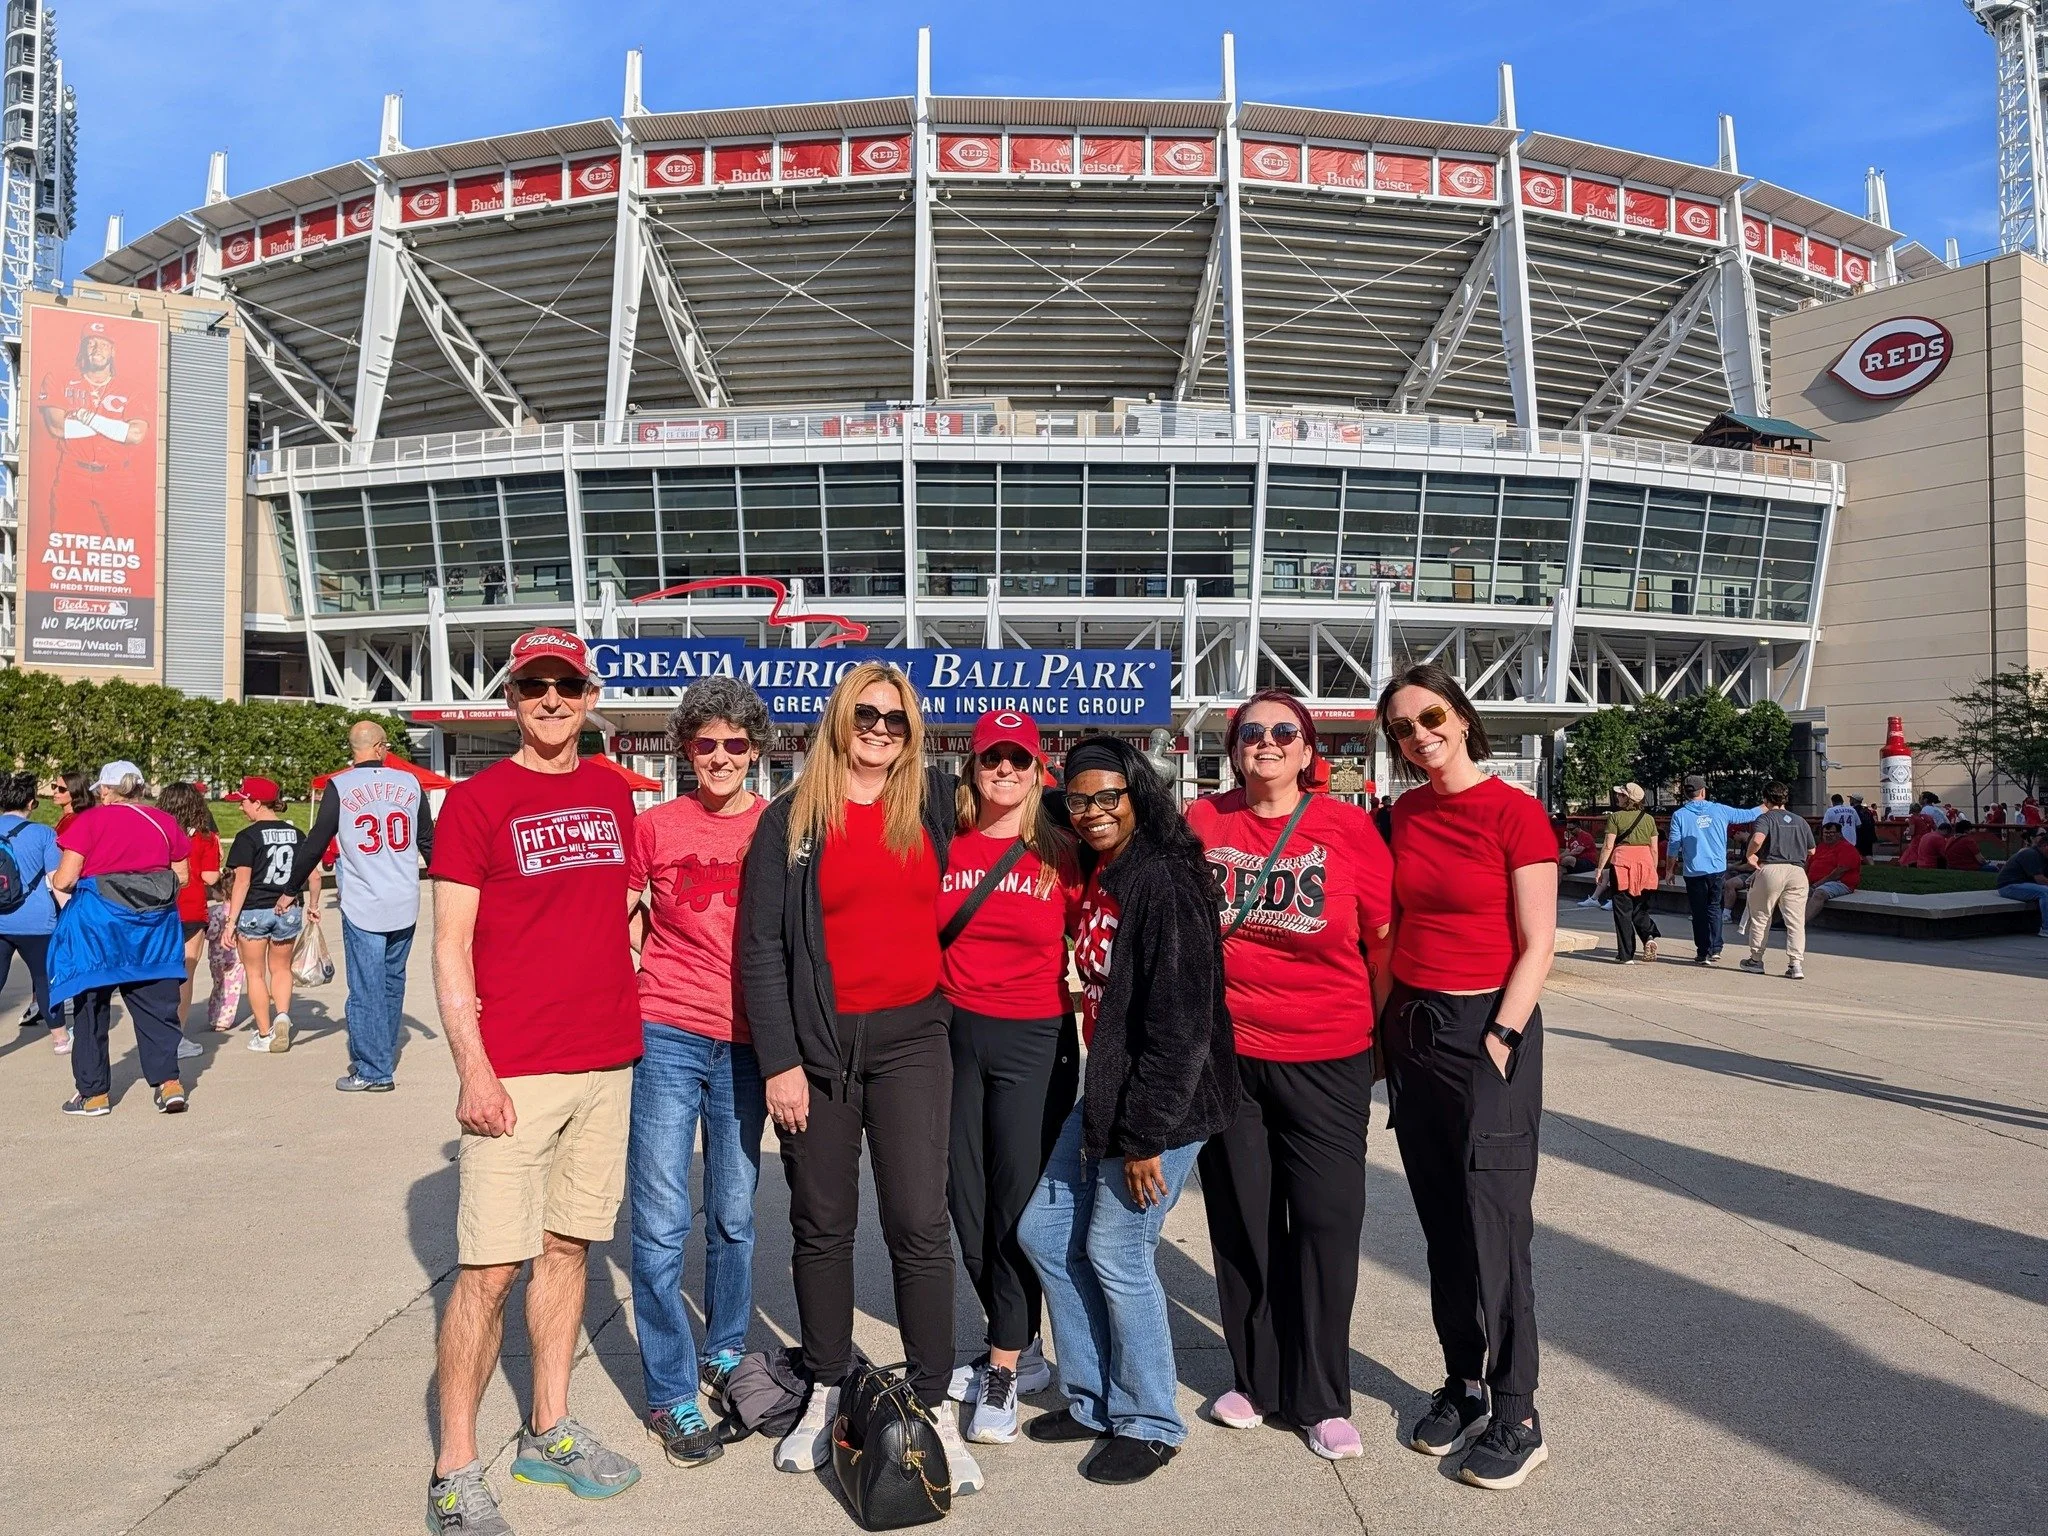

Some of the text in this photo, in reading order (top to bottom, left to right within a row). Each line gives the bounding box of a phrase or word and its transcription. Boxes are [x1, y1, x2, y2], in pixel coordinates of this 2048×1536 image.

[871, 150, 900, 160] REDS
[960, 148, 988, 158] REDS
[1175, 152, 1203, 163] REDS
[667, 164, 694, 173] REDS
[1262, 158, 1289, 168] REDS
[588, 170, 613, 182] REDS
[1458, 175, 1484, 186] REDS
[1534, 185, 1556, 197] REDS
[418, 197, 440, 208] REDS
[1690, 216, 1710, 227] REDS
[1864, 337, 1945, 373] REDS
[48, 532, 135, 553] STREAM
[41, 549, 141, 570] ALL REDS
[51, 565, 127, 584] GAMES
[50, 582, 132, 594] IN REDS TERRITORY!
[41, 616, 59, 630] NO
[520, 633, 579, 650] Titleist
[594, 644, 1146, 690] GREAT AMERICN BALL PARK
[773, 696, 829, 713] GREA
[955, 697, 1069, 715] INSURANCE
[1078, 697, 1146, 715] GROUP
[457, 710, 465, 719] A
[1324, 710, 1355, 718] TERRACE
[1040, 737, 1054, 751] OF
[341, 781, 419, 813] GRIFFEY
[1889, 793, 1911, 801] Buds
[551, 814, 569, 824] WHERE
[1838, 814, 1853, 827] 44
[263, 829, 297, 844] VOTTO
[354, 810, 411, 856] 30
[520, 823, 567, 852] FIFTY
[578, 820, 617, 842] WEST
[568, 842, 587, 853] MILE
[262, 844, 294, 886] 19
[942, 868, 1052, 902] CINCNA
